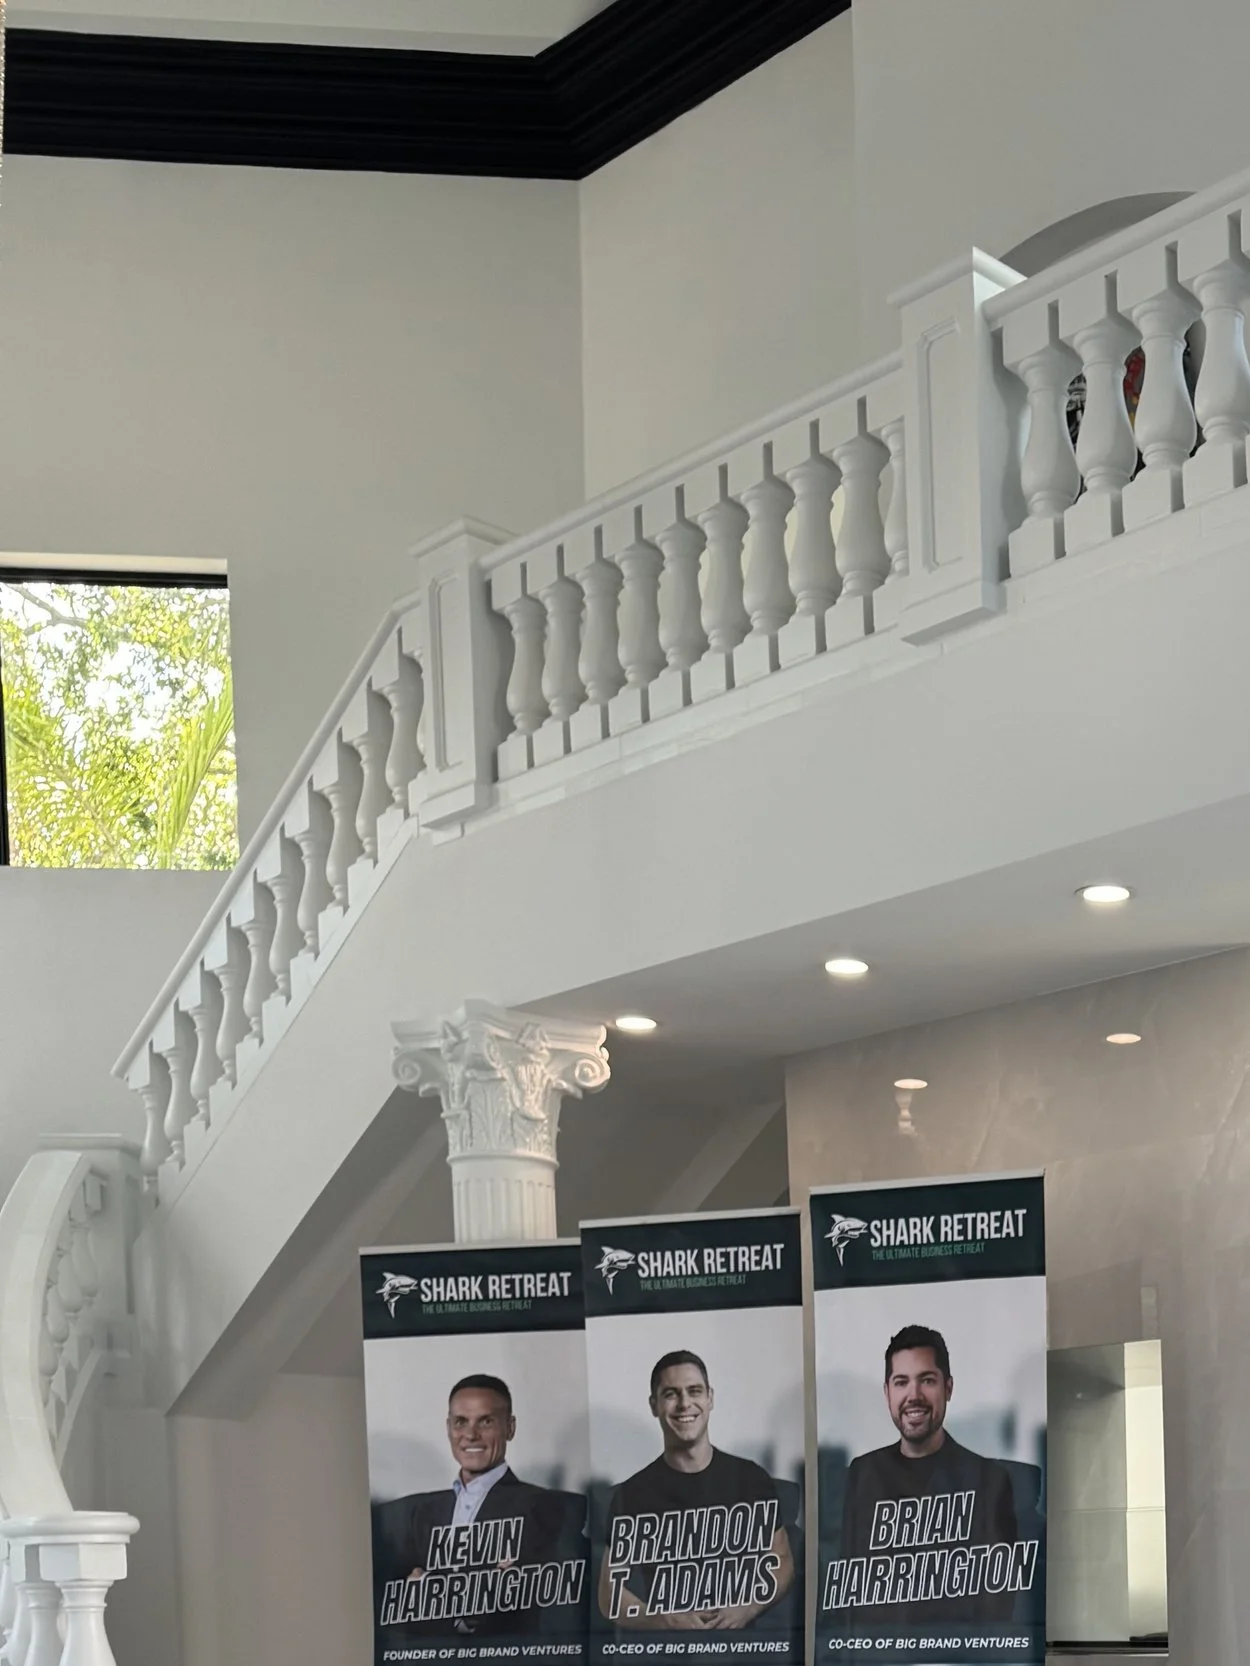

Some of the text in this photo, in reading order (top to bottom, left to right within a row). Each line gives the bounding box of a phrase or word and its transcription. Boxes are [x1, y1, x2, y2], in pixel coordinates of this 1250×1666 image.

[870, 1209, 1027, 1247] SHARK RETREAT
[637, 1244, 784, 1278] SHARK RETREAT
[872, 1242, 985, 1260] THE ULTIMATE BUSINESS RETREAT
[420, 1272, 572, 1303] SHARK RETREAT
[640, 1274, 746, 1291] THE ULTIMATE BUSINESS RETREAT
[422, 1299, 532, 1315] THE ULTIMATE BUSINESS RETREAT
[608, 1500, 778, 1567] BRANDON
[869, 1490, 975, 1550] BRIAN
[426, 1517, 524, 1572] KEVIN
[609, 1553, 780, 1619] T. ADAMS
[822, 1540, 1039, 1610] HARRINGTON
[380, 1559, 585, 1626] HARRINGTON
[383, 1644, 583, 1661] FOUNDER OF BIG BRAND VENTURES
[602, 1642, 790, 1655] CO-CEO OF BIG BRAND VENTURES
[828, 1637, 1029, 1649] CO-CEO OF BIG BRAND VENTURES
